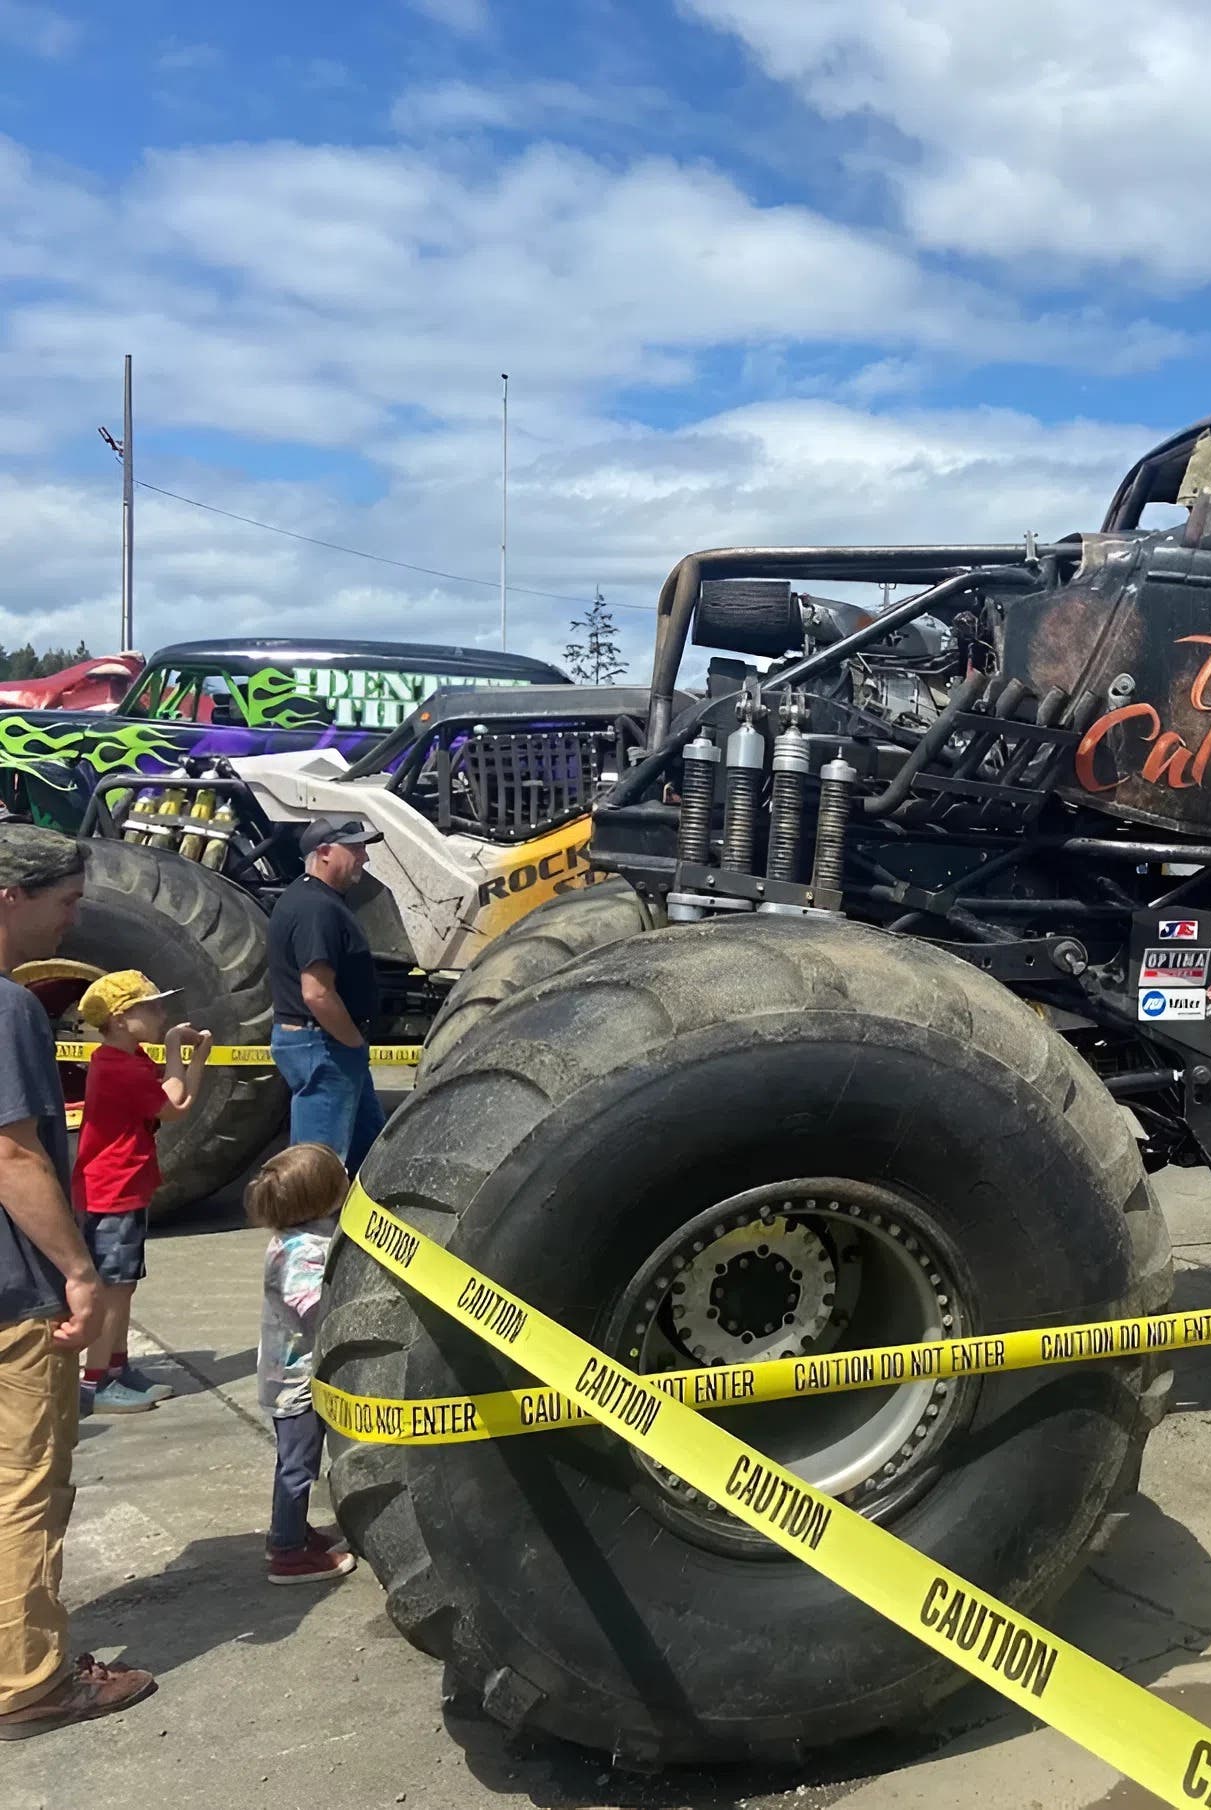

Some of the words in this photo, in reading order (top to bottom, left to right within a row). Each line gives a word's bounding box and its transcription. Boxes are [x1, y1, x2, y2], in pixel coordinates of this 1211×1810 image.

[364, 1210, 422, 1269] CAUTION
[456, 1277, 529, 1344] CAUTION
[1041, 1326, 1114, 1361] CAUTION
[1119, 1324, 1141, 1349] DO
[1146, 1318, 1177, 1348] NOT
[794, 1358, 874, 1392] CAUTION
[881, 1353, 902, 1381] DO
[910, 1346, 943, 1377] NOT
[951, 1339, 1006, 1371] ENTER
[354, 1403, 373, 1434] DO
[411, 1402, 478, 1437] ENTER
[520, 1392, 592, 1426] CAUTI
[694, 1369, 755, 1404] ENTER
[574, 1357, 662, 1437] CAUTION
[724, 1454, 836, 1552] CAUTION
[919, 1576, 1060, 1699] CAUTION
